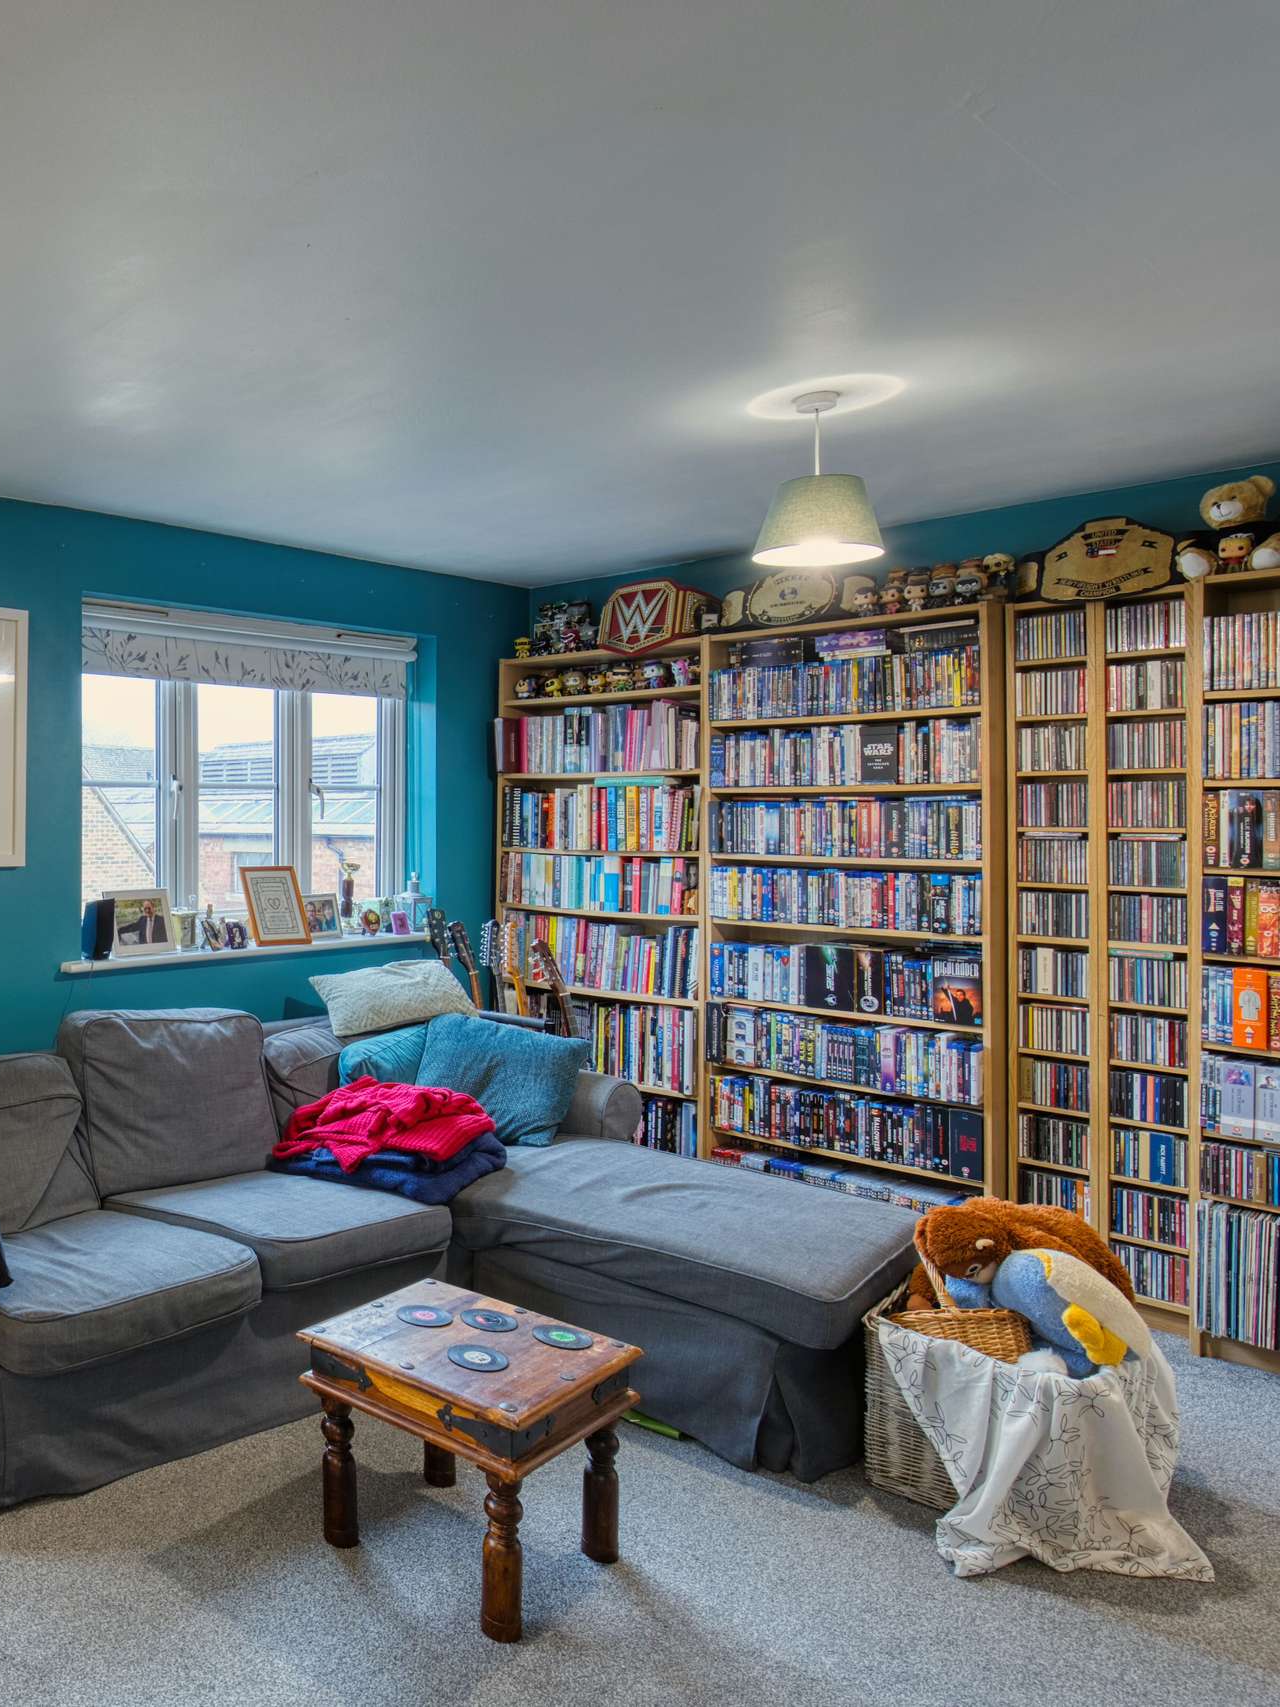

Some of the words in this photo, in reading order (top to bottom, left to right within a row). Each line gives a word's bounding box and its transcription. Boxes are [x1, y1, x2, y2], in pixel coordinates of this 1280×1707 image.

[1080, 587, 1116, 597] CHAMPION
[864, 748, 894, 756] WARS
[934, 960, 979, 978] HIGHLANDER
[873, 1117, 881, 1152] HALLOWEEN
